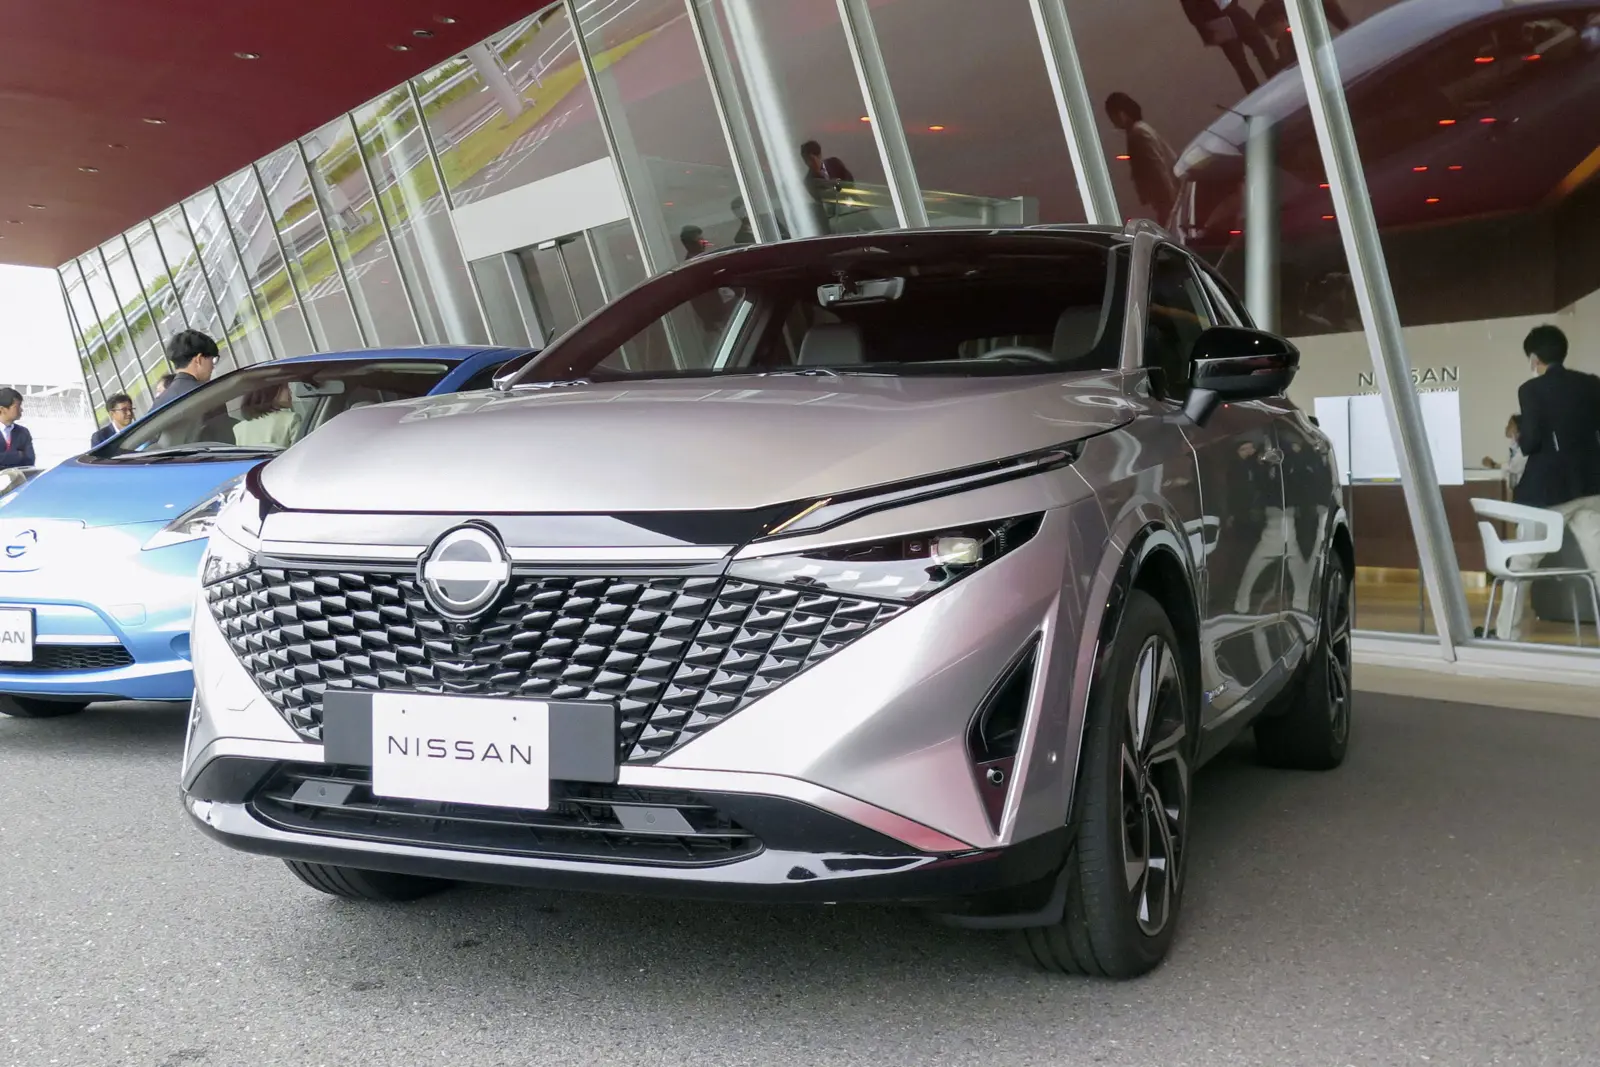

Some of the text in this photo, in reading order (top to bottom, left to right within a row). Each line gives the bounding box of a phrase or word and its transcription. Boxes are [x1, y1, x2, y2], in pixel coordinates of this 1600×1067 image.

[1358, 366, 1459, 387] NSAN
[0, 630, 25, 644] AN
[388, 735, 532, 765] NISSAN
